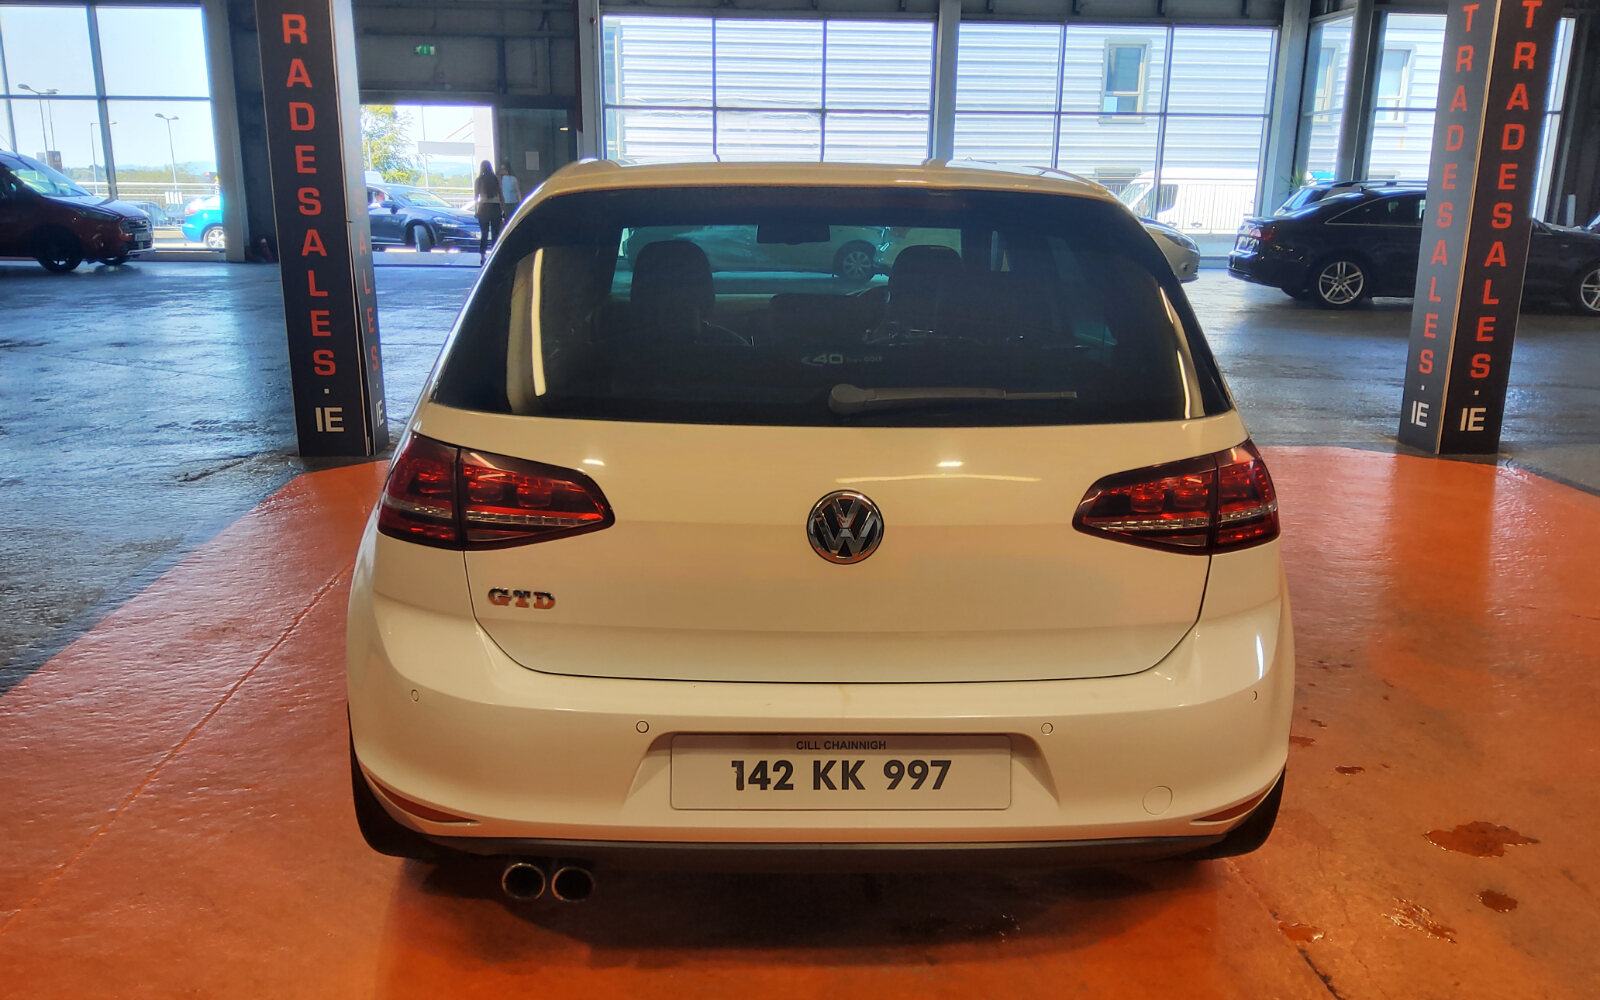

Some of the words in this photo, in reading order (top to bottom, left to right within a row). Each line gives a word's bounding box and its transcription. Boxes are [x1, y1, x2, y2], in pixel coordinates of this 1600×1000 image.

[487, 587, 556, 610] GTD
[796, 740, 821, 750] CILL
[823, 740, 886, 750] CHAINNIGH
[731, 760, 794, 791] 142
[812, 760, 866, 790] KK
[883, 760, 952, 790] 997
